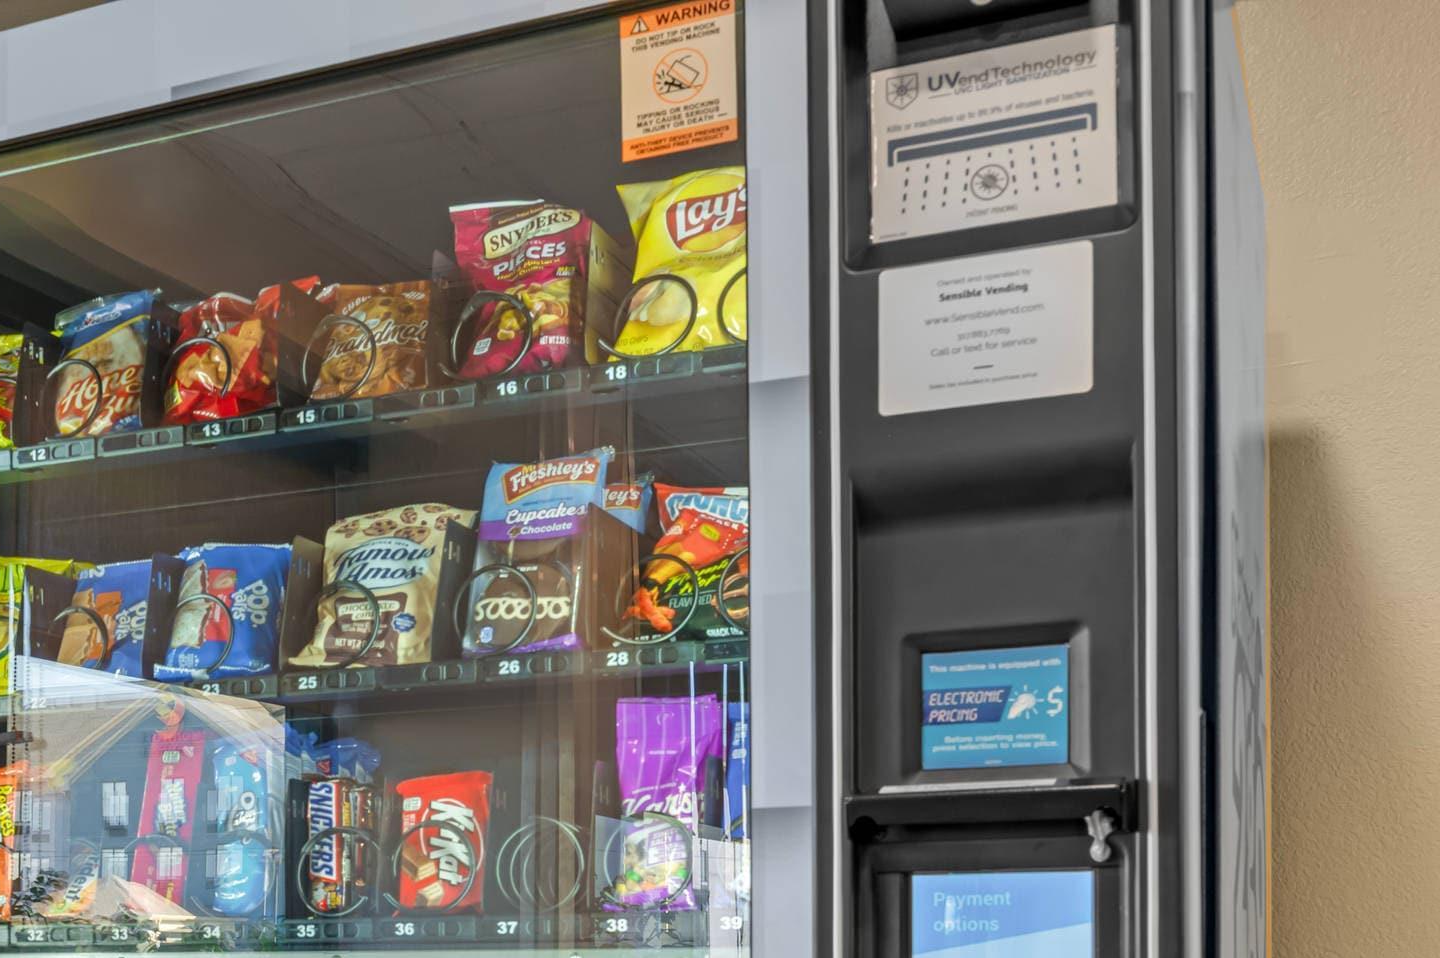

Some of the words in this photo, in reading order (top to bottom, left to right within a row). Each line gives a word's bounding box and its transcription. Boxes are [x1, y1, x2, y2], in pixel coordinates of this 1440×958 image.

[656, 0, 730, 25] WARNING
[489, 210, 573, 252] SNYDER'S
[939, 288, 982, 302] Sensible
[985, 283, 1029, 296] Vending
[605, 366, 627, 380] 18
[496, 381, 518, 396] 16
[296, 410, 315, 424] 15
[202, 424, 221, 437] 13
[29, 448, 47, 462] 12
[510, 460, 596, 492] Freshley's
[506, 502, 588, 525] Cupcakes
[520, 522, 573, 535] Chocolate
[334, 545, 436, 570] Famous
[335, 562, 420, 582] Amos
[606, 652, 629, 667] 28
[498, 661, 520, 675] 26
[202, 684, 220, 695] 23
[298, 676, 317, 690] 25
[928, 689, 1005, 706] ELECTRONIC
[928, 708, 978, 723] PRICING
[933, 892, 1011, 909] Payment
[394, 922, 415, 936] 36
[496, 921, 518, 935] 37
[606, 919, 628, 933] 38
[719, 916, 742, 930] 39
[933, 917, 1000, 935] options
[27, 930, 44, 941] 32
[111, 929, 128, 940] 33
[203, 926, 221, 938] 34
[296, 925, 316, 937] 35
